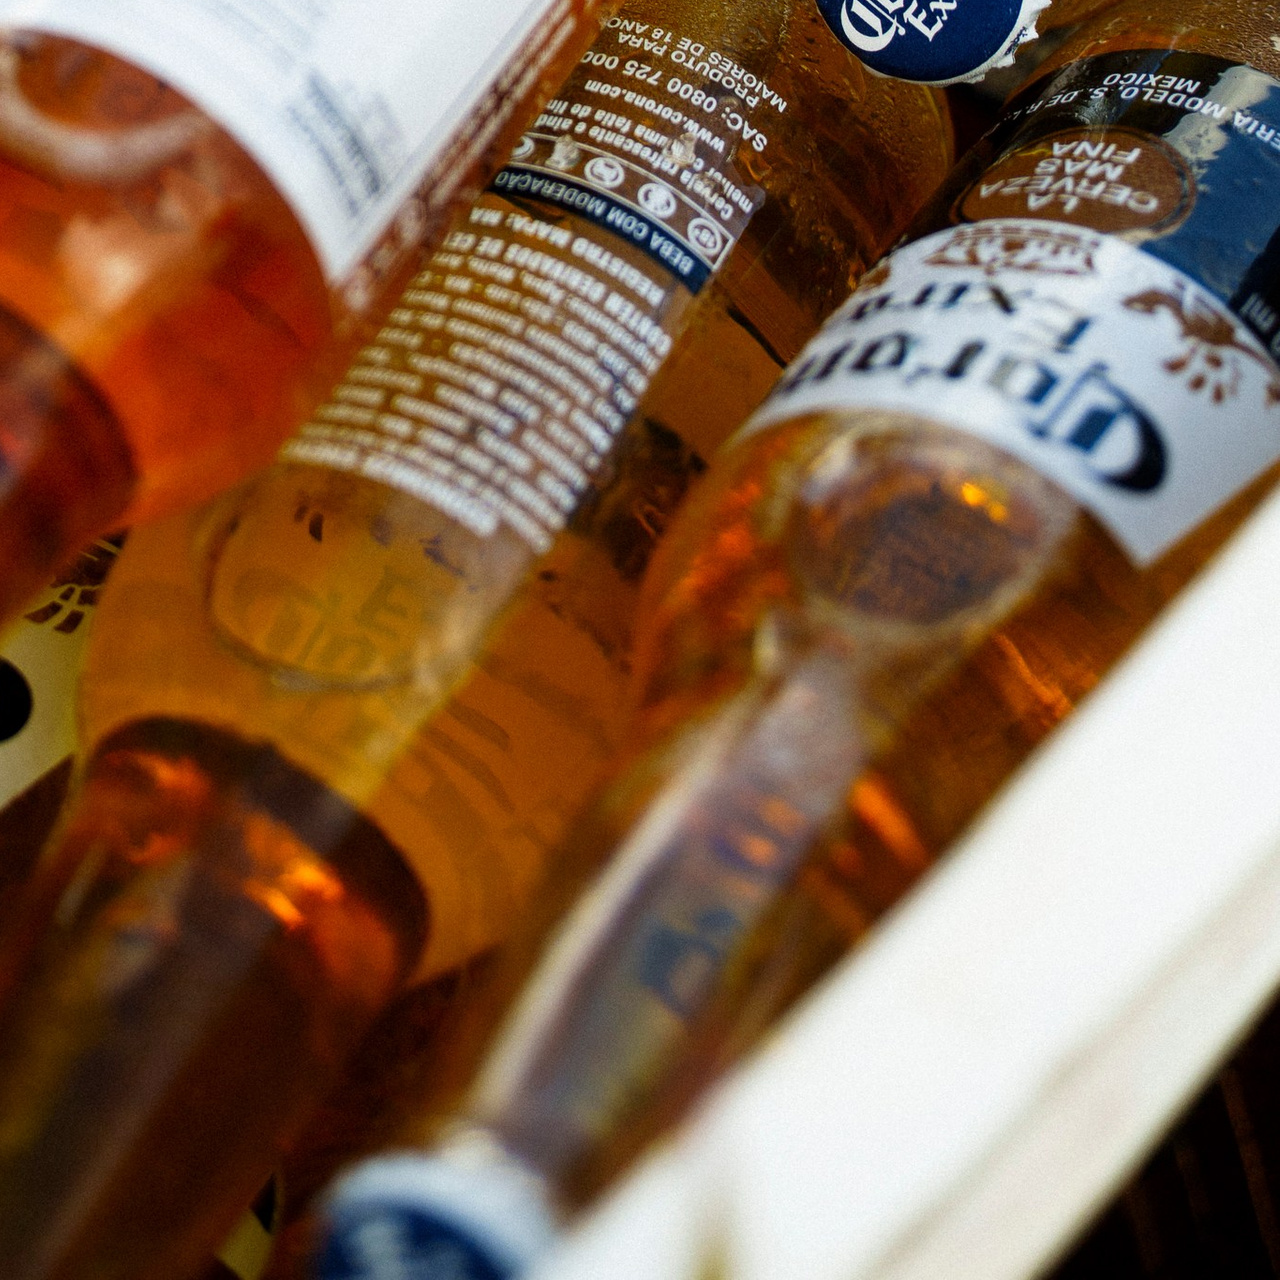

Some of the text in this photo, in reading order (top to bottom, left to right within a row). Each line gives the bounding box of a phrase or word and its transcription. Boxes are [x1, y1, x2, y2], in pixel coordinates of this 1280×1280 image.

[605, 16, 787, 113] MAIORES DE 18 ANO
[618, 31, 759, 108] PRODUTO PARA
[622, 58, 661, 85] 725
[1104, 72, 1201, 93] MEXICO
[569, 102, 592, 117] de
[664, 75, 719, 113] 0800
[572, 120, 587, 136] e
[584, 78, 724, 152] www.corona.com
[593, 108, 630, 134] fatia
[720, 106, 767, 153] SAC:
[586, 126, 678, 176] refrescante
[632, 120, 668, 150] uma
[1051, 141, 1142, 164] FINA
[1035, 157, 1130, 182] MAS
[678, 169, 733, 221] Cerveja
[979, 178, 1160, 215] CERVEZA
[1027, 192, 1082, 215] LA
[492, 169, 694, 276] BEBA COM MODERAÇÃO
[782, 332, 1168, 494] Coron
